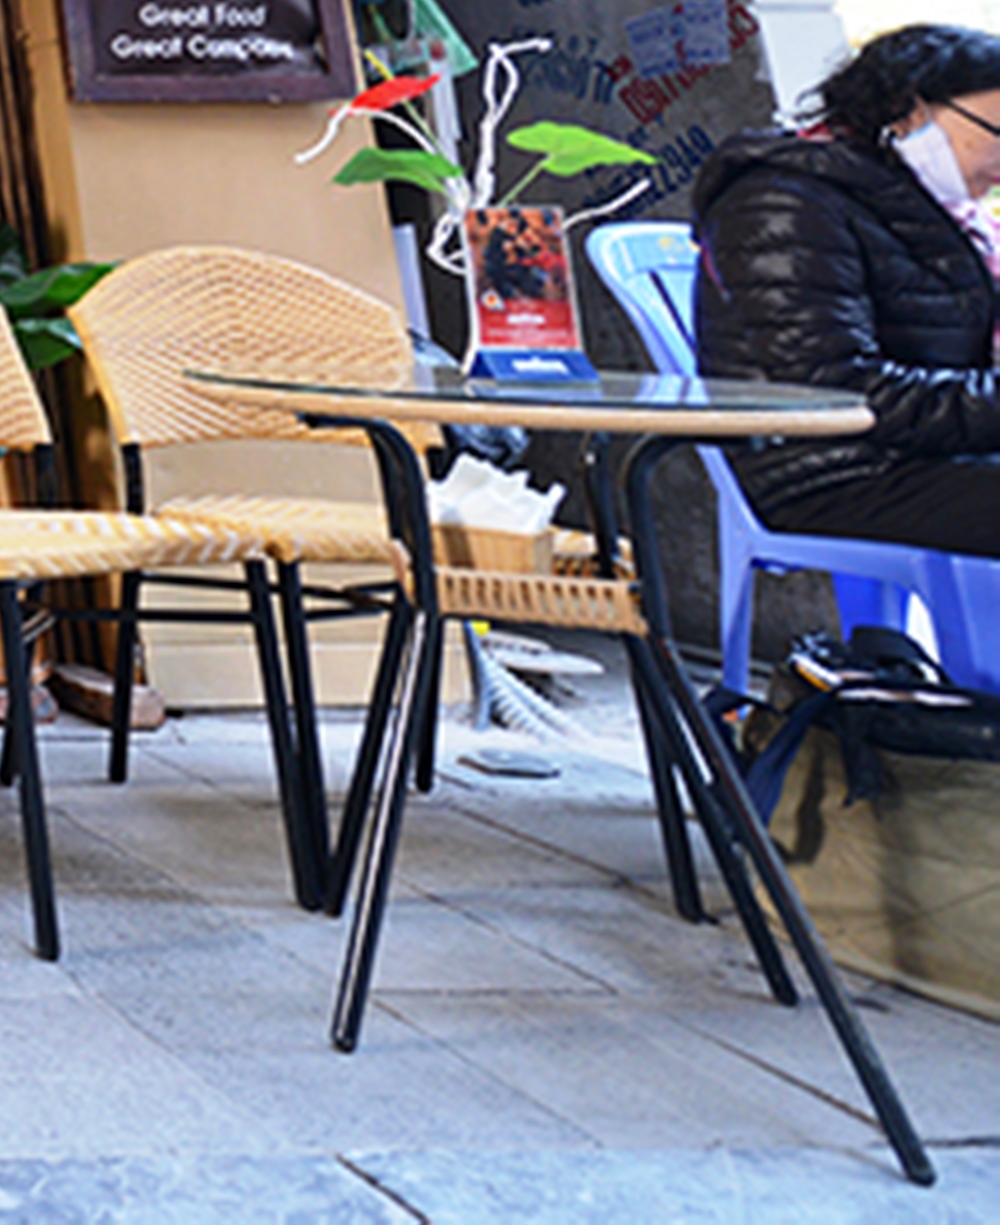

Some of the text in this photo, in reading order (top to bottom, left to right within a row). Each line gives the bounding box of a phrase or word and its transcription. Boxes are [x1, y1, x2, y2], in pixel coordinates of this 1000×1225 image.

[138, 3, 267, 27] Great Food
[110, 33, 183, 60] Great
